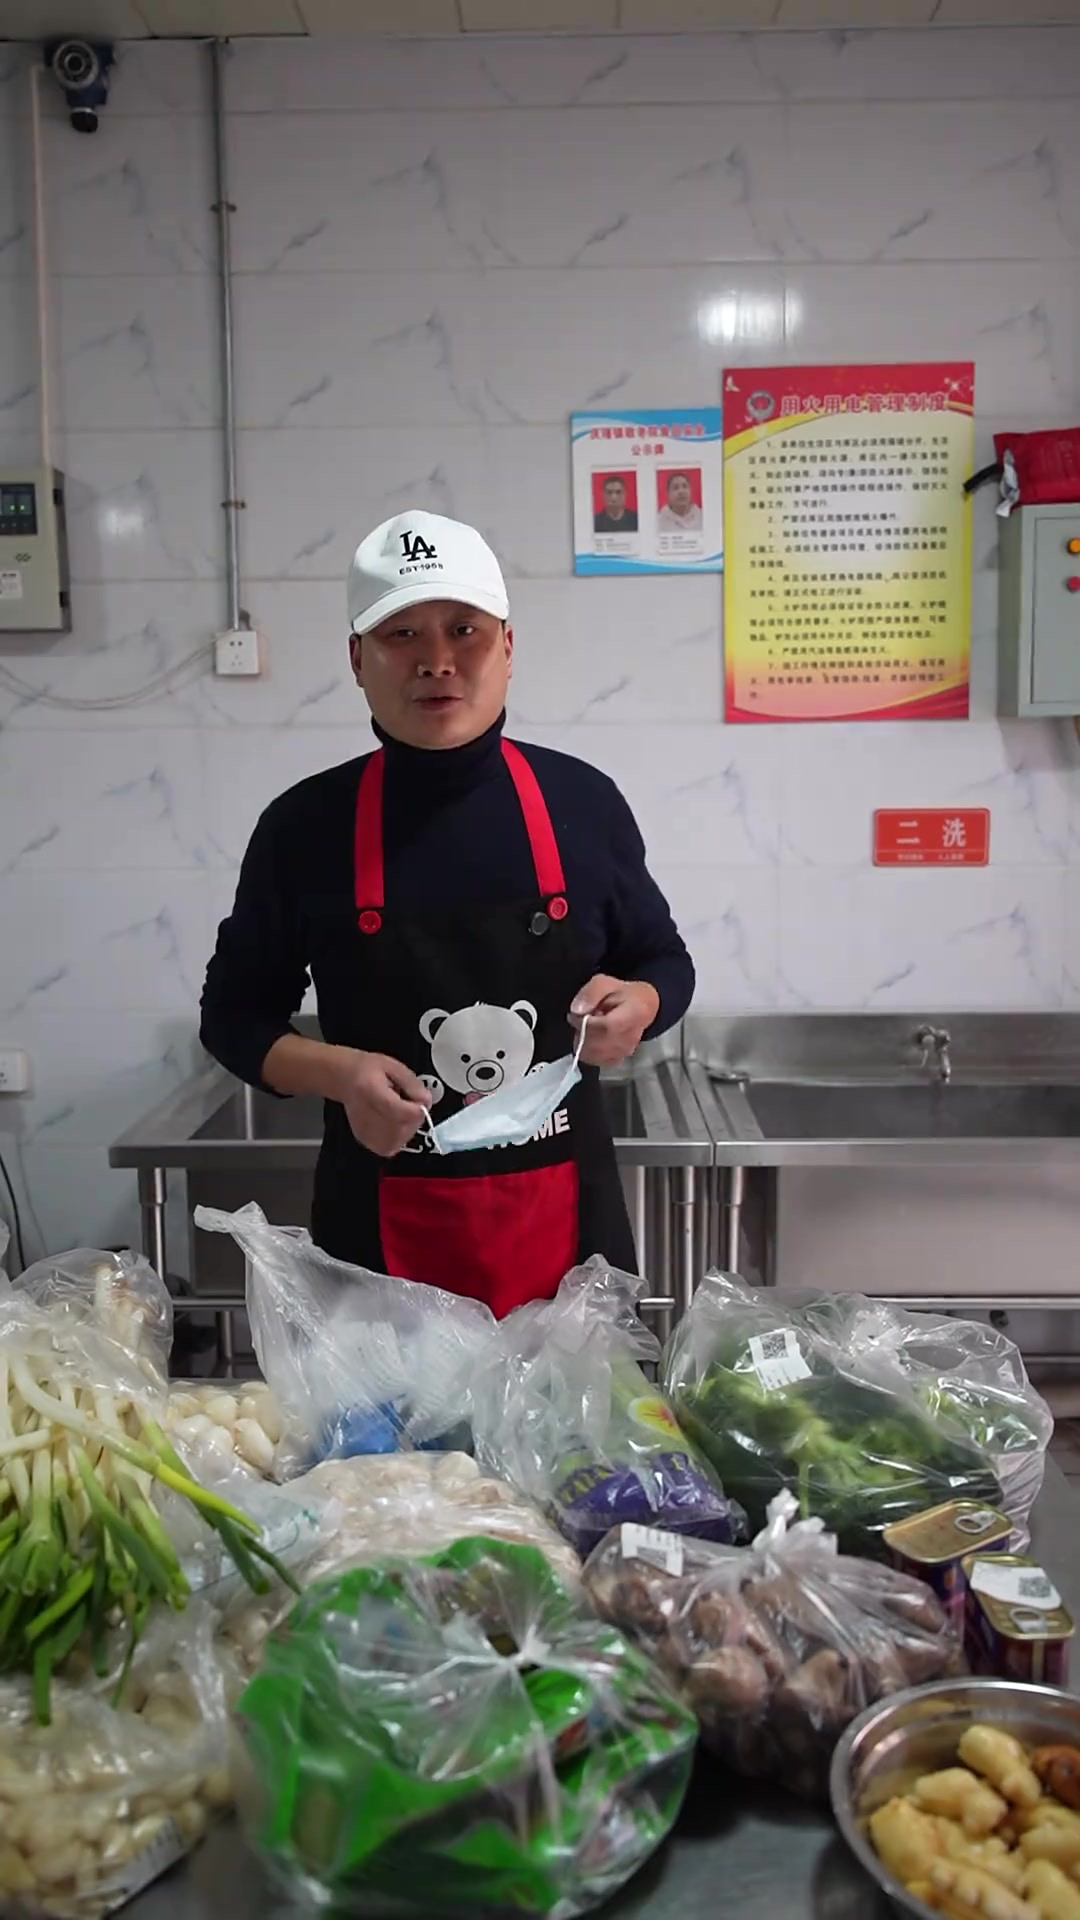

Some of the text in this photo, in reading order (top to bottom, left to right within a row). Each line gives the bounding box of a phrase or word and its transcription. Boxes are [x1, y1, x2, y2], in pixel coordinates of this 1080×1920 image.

[780, 393, 948, 415] 用火用电管理制度
[400, 530, 437, 562] LA
